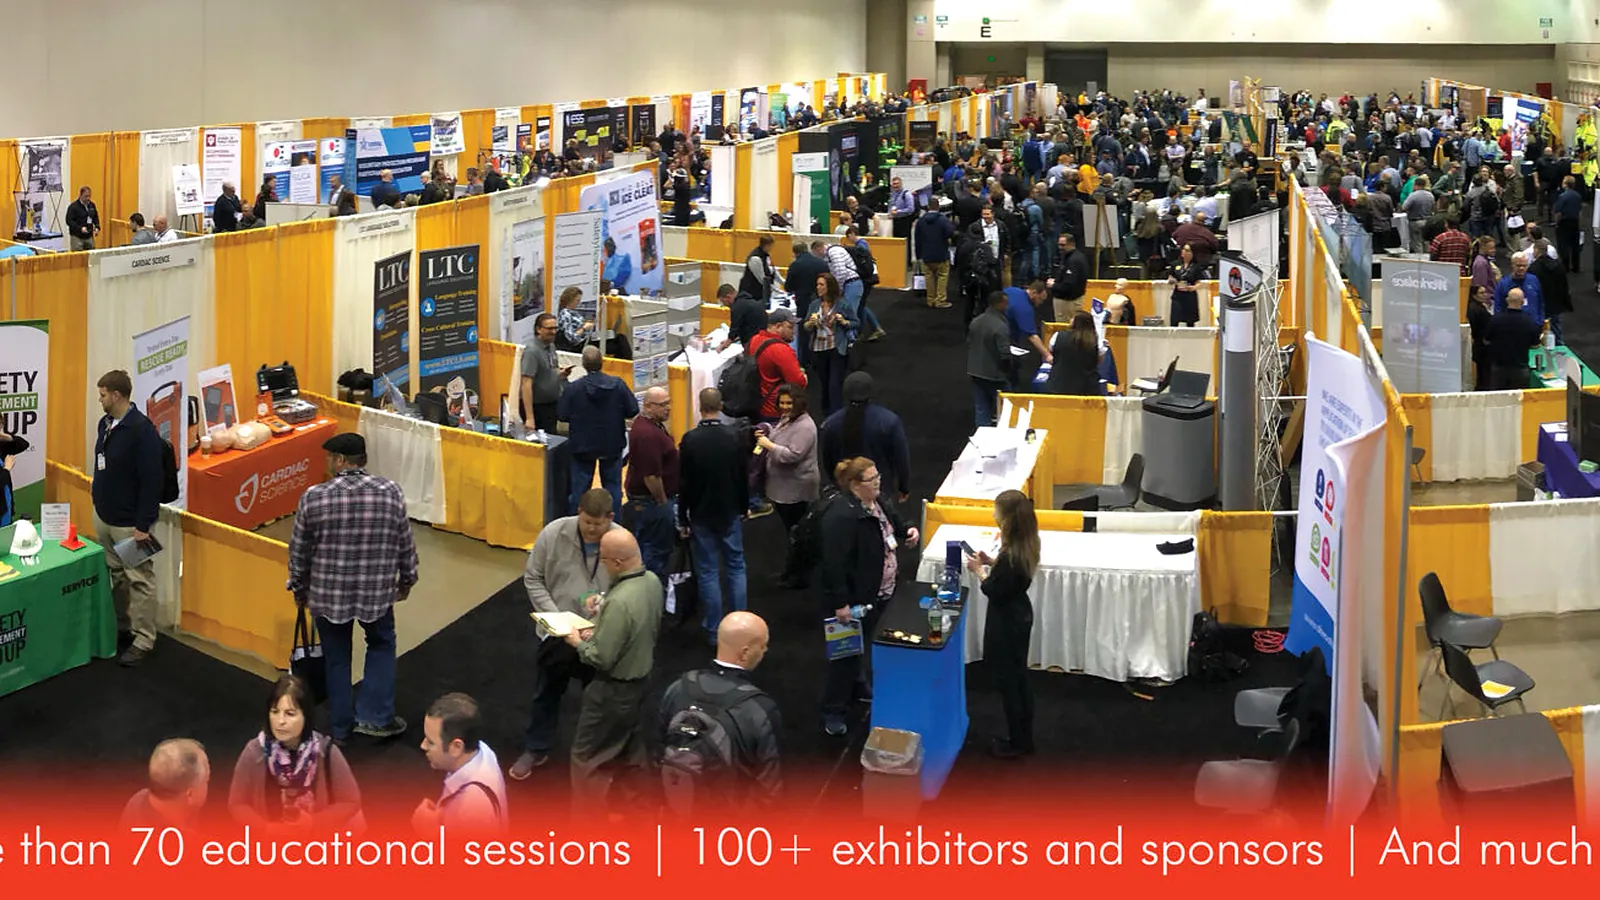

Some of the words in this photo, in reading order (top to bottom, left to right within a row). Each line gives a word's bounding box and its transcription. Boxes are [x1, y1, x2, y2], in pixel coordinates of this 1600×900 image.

[980, 26, 991, 38] E
[132, 258, 151, 268] CARDIAC
[428, 253, 475, 280] LTC
[379, 261, 408, 291] LTC
[140, 351, 164, 372] RESCUE
[260, 457, 309, 488] CARDIAC
